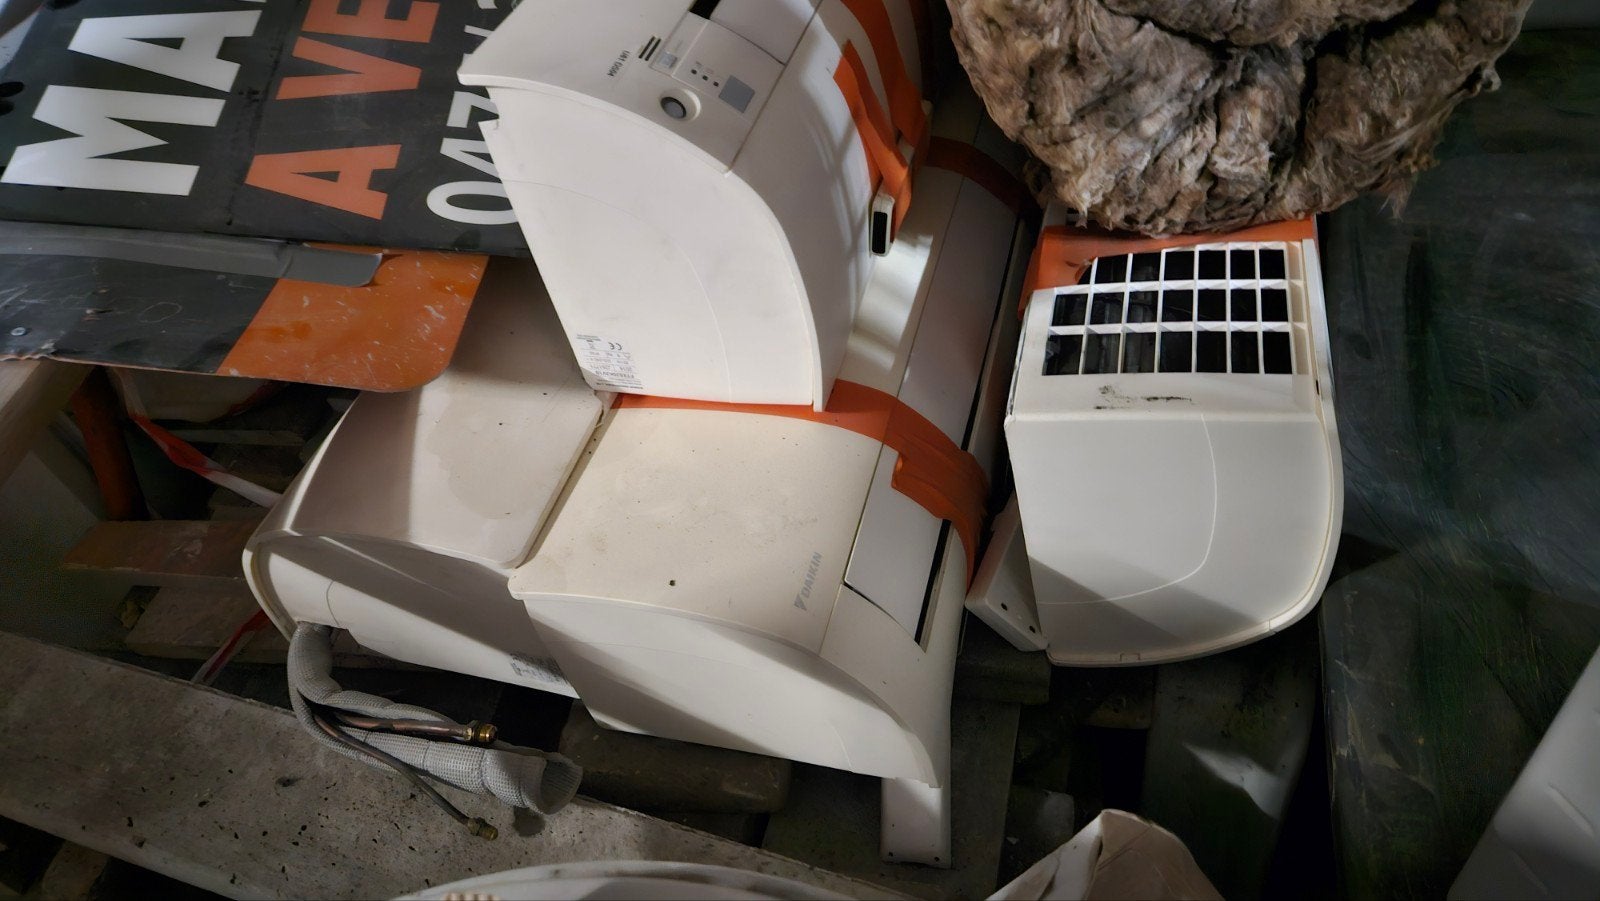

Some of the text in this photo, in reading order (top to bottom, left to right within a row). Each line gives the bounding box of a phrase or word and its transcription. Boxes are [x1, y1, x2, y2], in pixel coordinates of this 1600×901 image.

[0, 0, 266, 196] MA
[244, 144, 402, 221] A
[800, 551, 822, 599] DAIKIN
